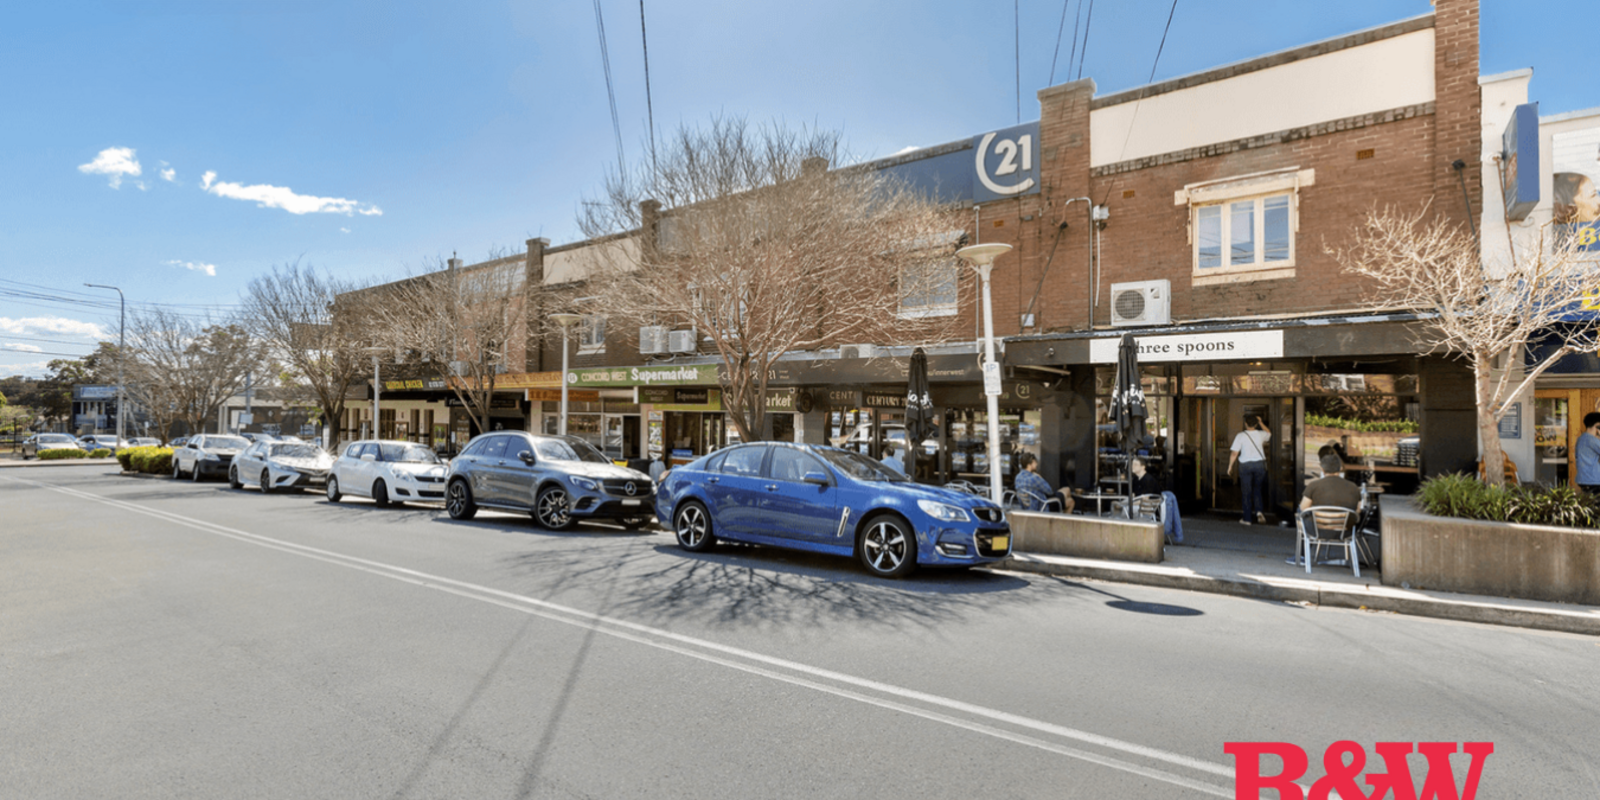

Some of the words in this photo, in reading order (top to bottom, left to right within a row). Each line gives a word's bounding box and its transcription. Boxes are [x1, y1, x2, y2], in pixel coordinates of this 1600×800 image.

[1580, 227, 1600, 245] B
[1136, 340, 1170, 353] hree
[1177, 341, 1235, 356] spoons
[581, 372, 610, 382] CONCORD
[611, 371, 627, 381] WEST
[631, 366, 698, 384] Supermarket
[866, 395, 900, 406] CENTURY
